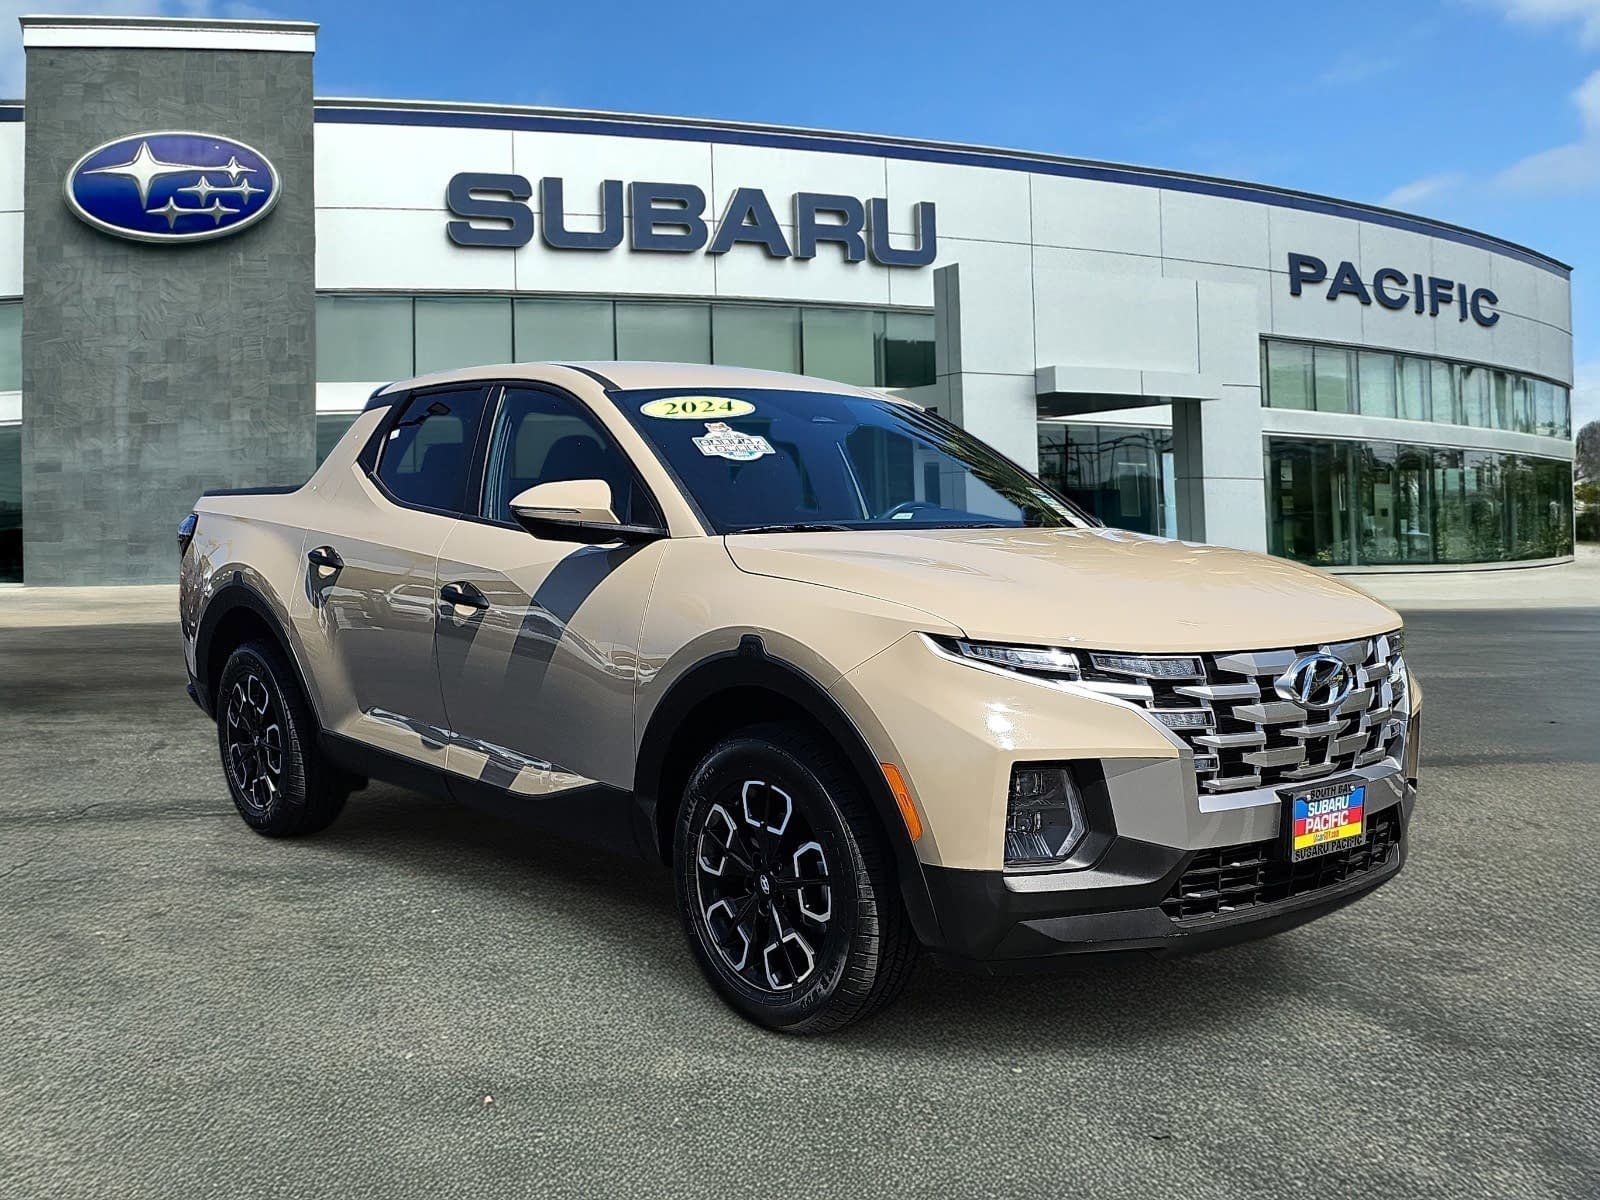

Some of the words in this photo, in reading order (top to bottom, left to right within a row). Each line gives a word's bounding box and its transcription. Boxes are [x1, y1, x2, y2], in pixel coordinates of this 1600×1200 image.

[446, 172, 938, 268] SUBARU
[1287, 252, 1500, 327] PACIFIC
[663, 400, 735, 415] 2024
[1310, 786, 1336, 800] SOUTH
[1307, 794, 1350, 817] SUBARU
[1305, 810, 1349, 834] PACIFIC
[1295, 843, 1329, 861] SUBARU
[1331, 836, 1363, 852] PACIFIC
